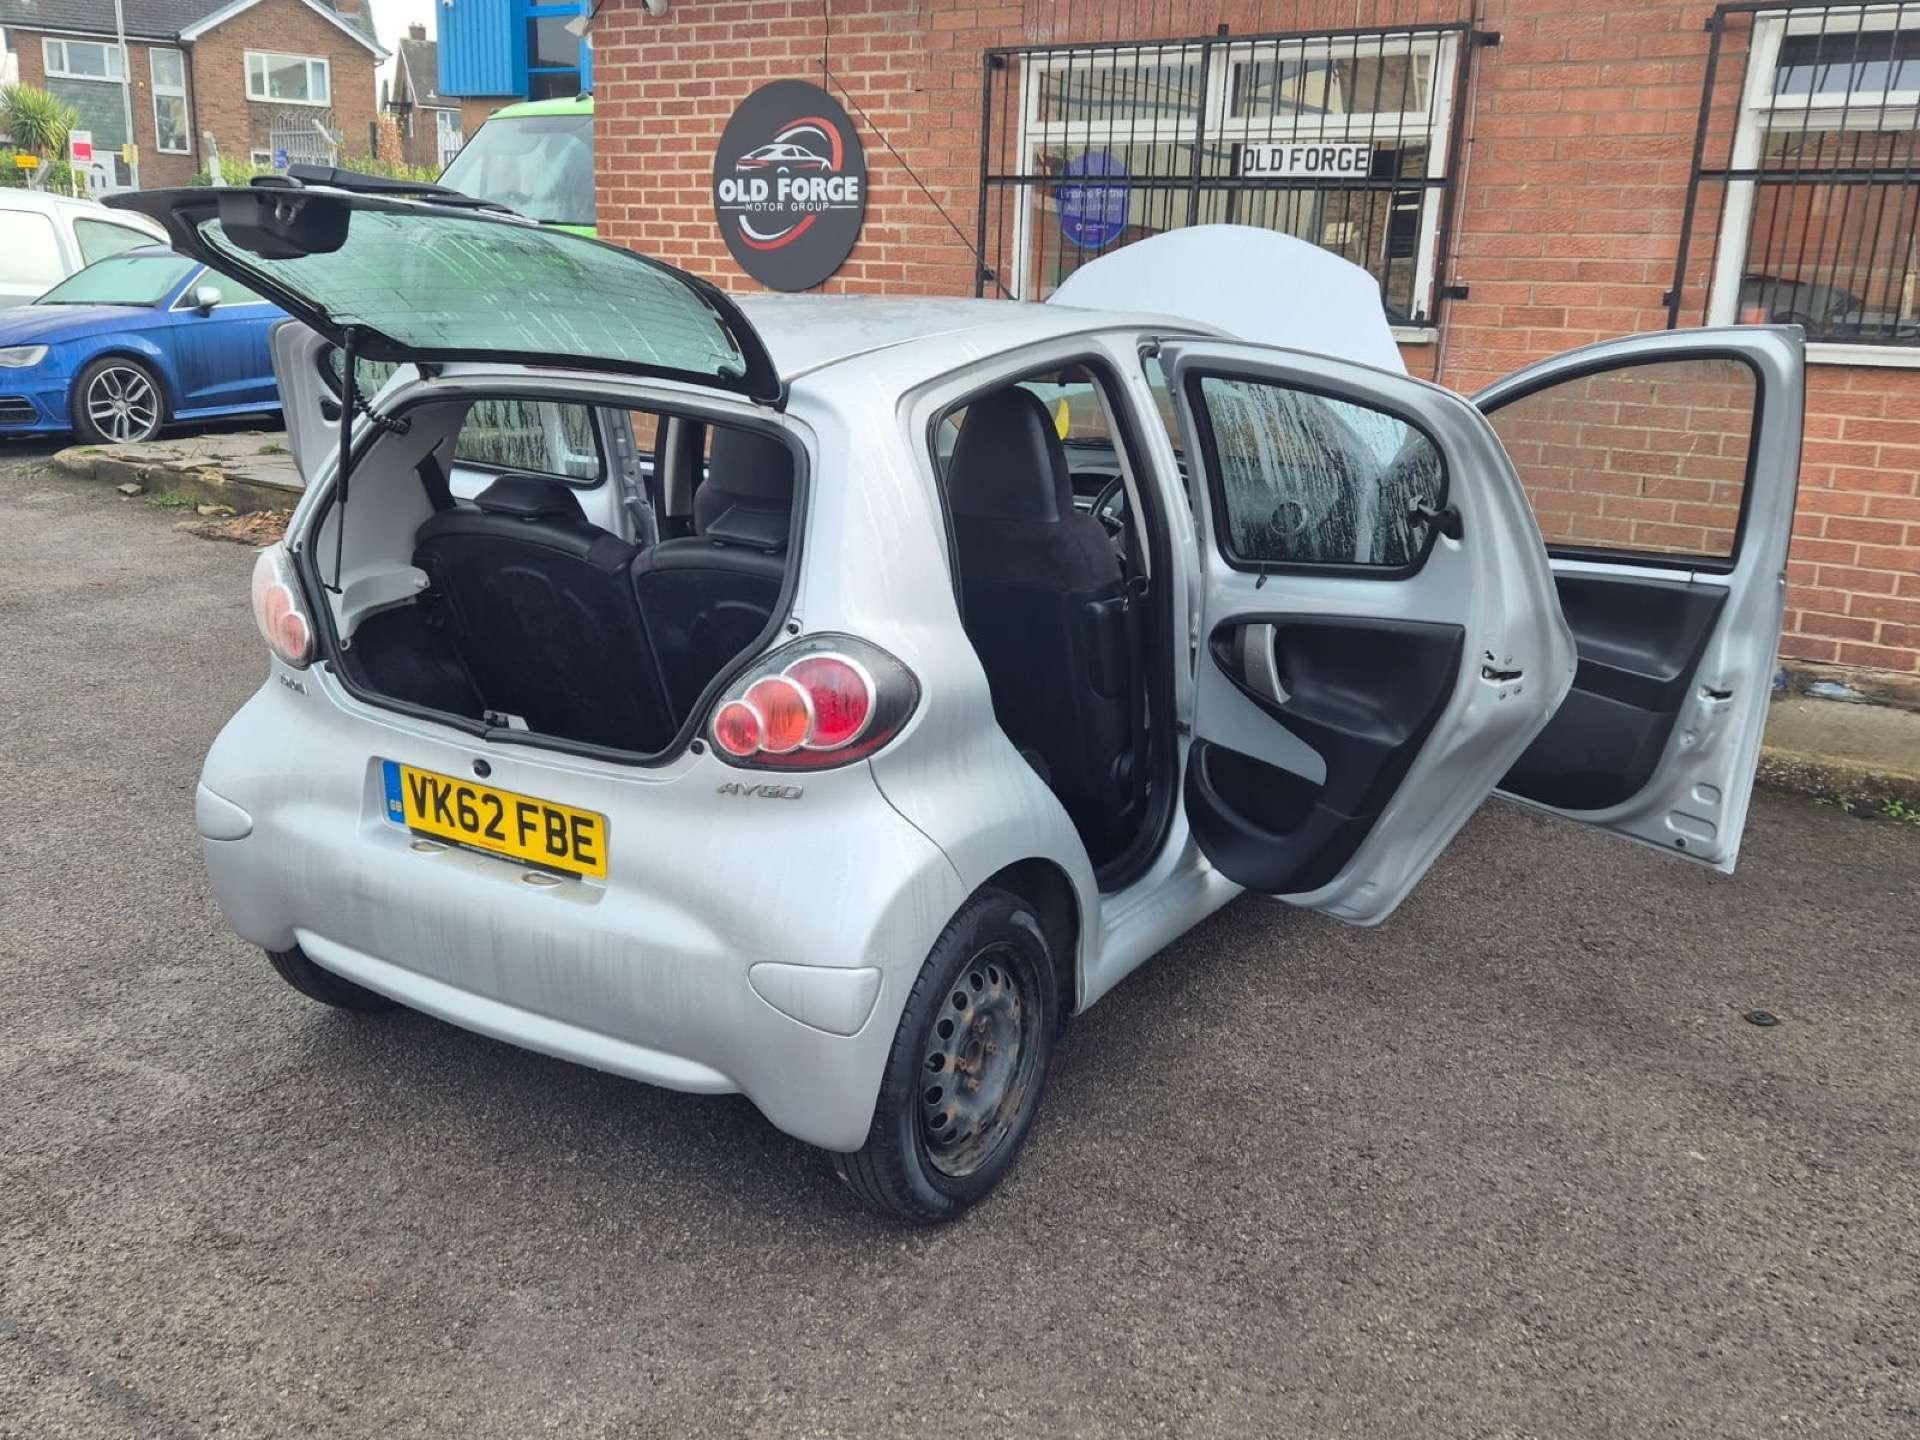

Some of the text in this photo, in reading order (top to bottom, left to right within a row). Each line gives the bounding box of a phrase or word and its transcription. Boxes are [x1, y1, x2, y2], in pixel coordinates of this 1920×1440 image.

[1243, 147, 1370, 172] OLD FORGE
[719, 176, 859, 202] OLD FORGE
[1060, 187, 1128, 199] Finane Patner
[745, 202, 830, 212] MOTOR GROUP
[716, 782, 804, 799] AYGO
[408, 773, 597, 866] VK62 FBE
